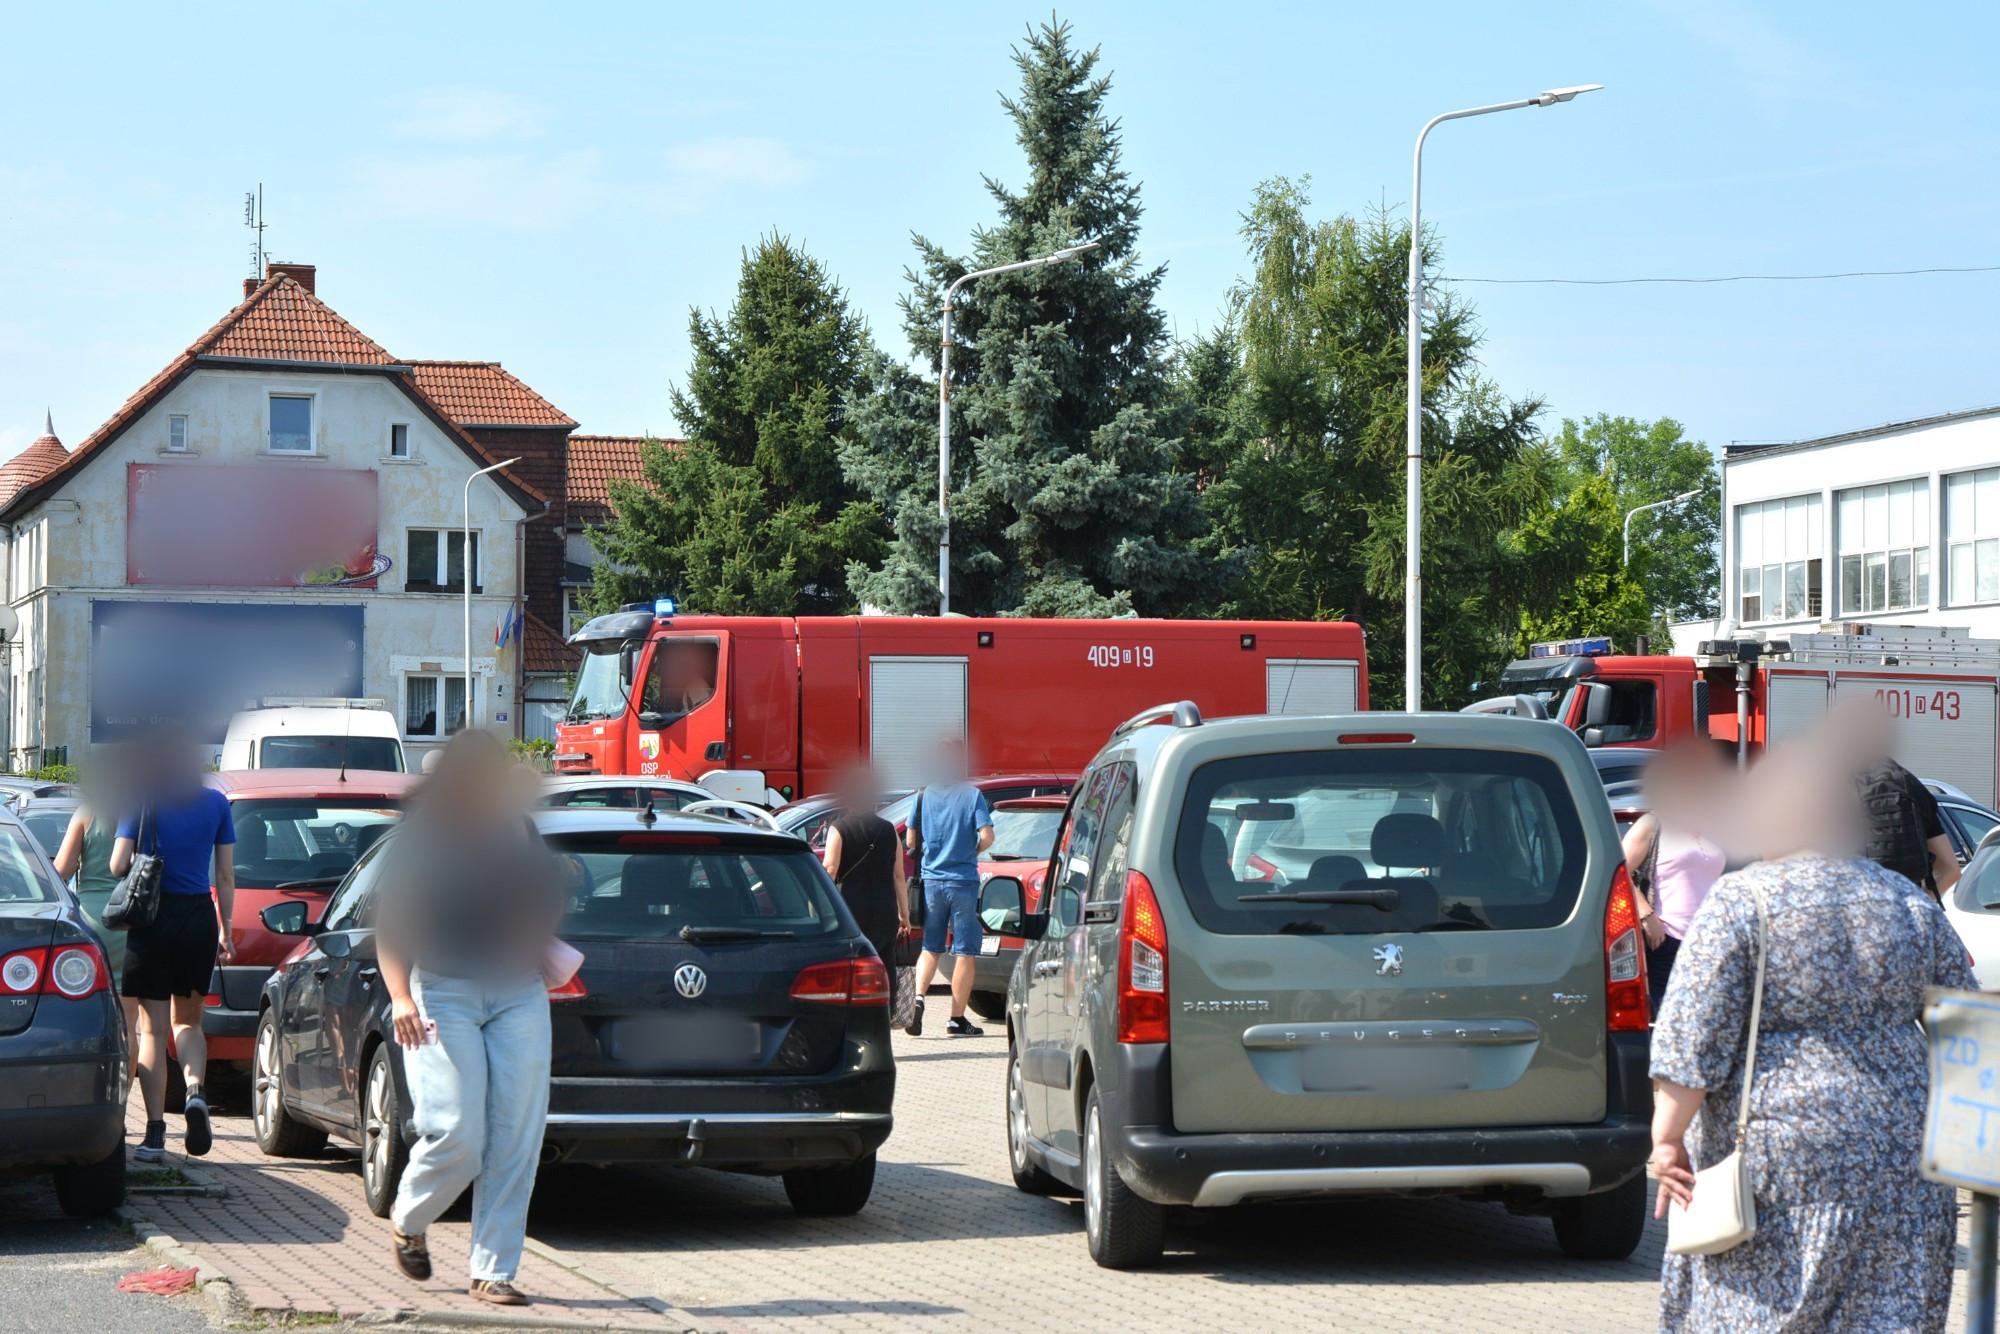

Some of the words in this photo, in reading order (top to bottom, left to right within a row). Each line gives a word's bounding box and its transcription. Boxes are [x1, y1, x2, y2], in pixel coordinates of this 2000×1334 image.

[641, 762, 659, 774] OSP
[1183, 1000, 1270, 1012] PARTNER
[1285, 1027, 1500, 1041] PEUGEOT
[1944, 1035, 1980, 1067] ZD
